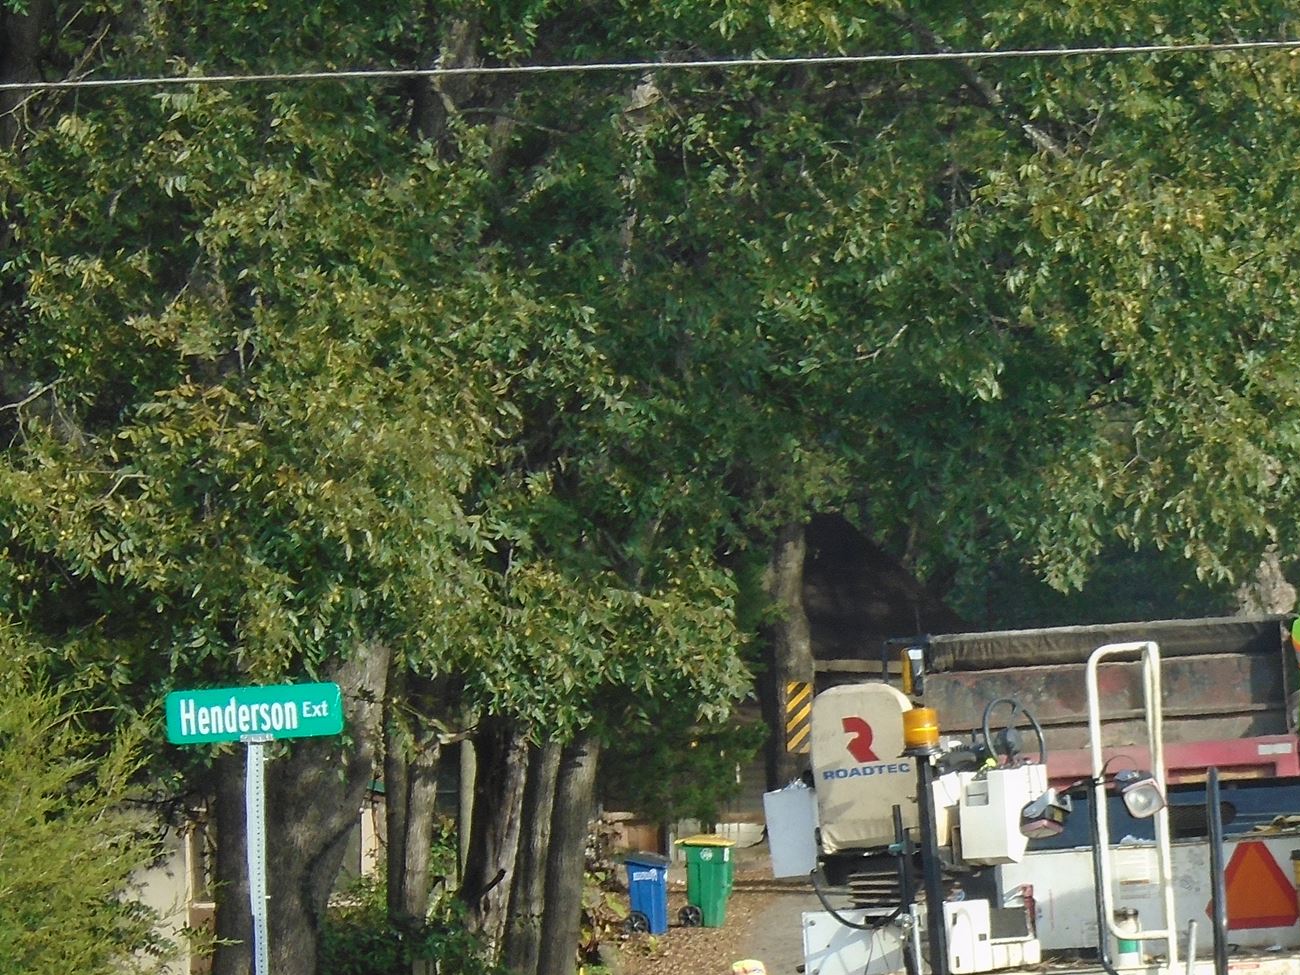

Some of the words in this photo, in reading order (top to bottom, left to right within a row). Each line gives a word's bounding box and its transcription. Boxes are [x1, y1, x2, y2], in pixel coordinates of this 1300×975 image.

[179, 696, 298, 736] Henderson
[302, 700, 329, 718] Ext
[822, 762, 911, 780] ROADTEC
